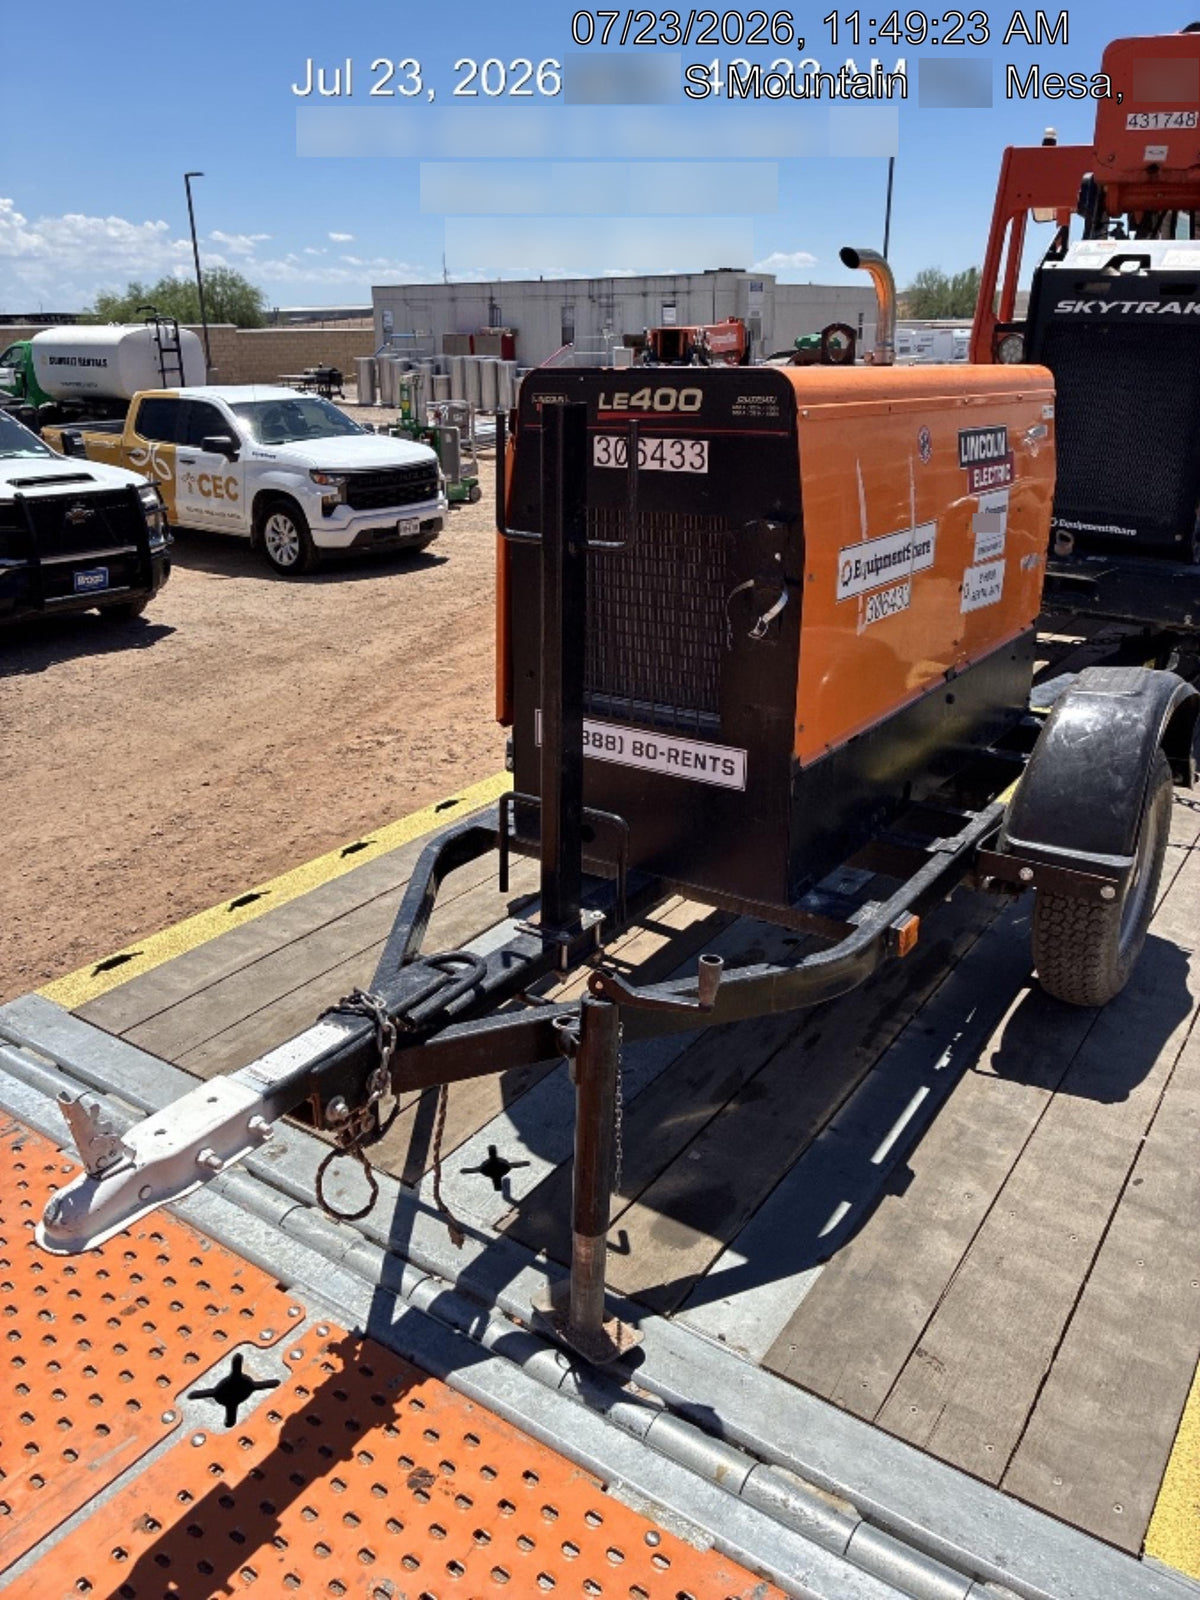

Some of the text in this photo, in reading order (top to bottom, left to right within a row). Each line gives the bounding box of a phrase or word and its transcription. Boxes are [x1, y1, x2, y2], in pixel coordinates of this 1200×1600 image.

[1128, 112, 1196, 128] 431748
[599, 387, 703, 412] LE400
[596, 437, 706, 471] 306433
[960, 431, 1006, 463] LINCOLN
[197, 473, 239, 501] CEC
[973, 463, 1011, 488] ELECTRIC
